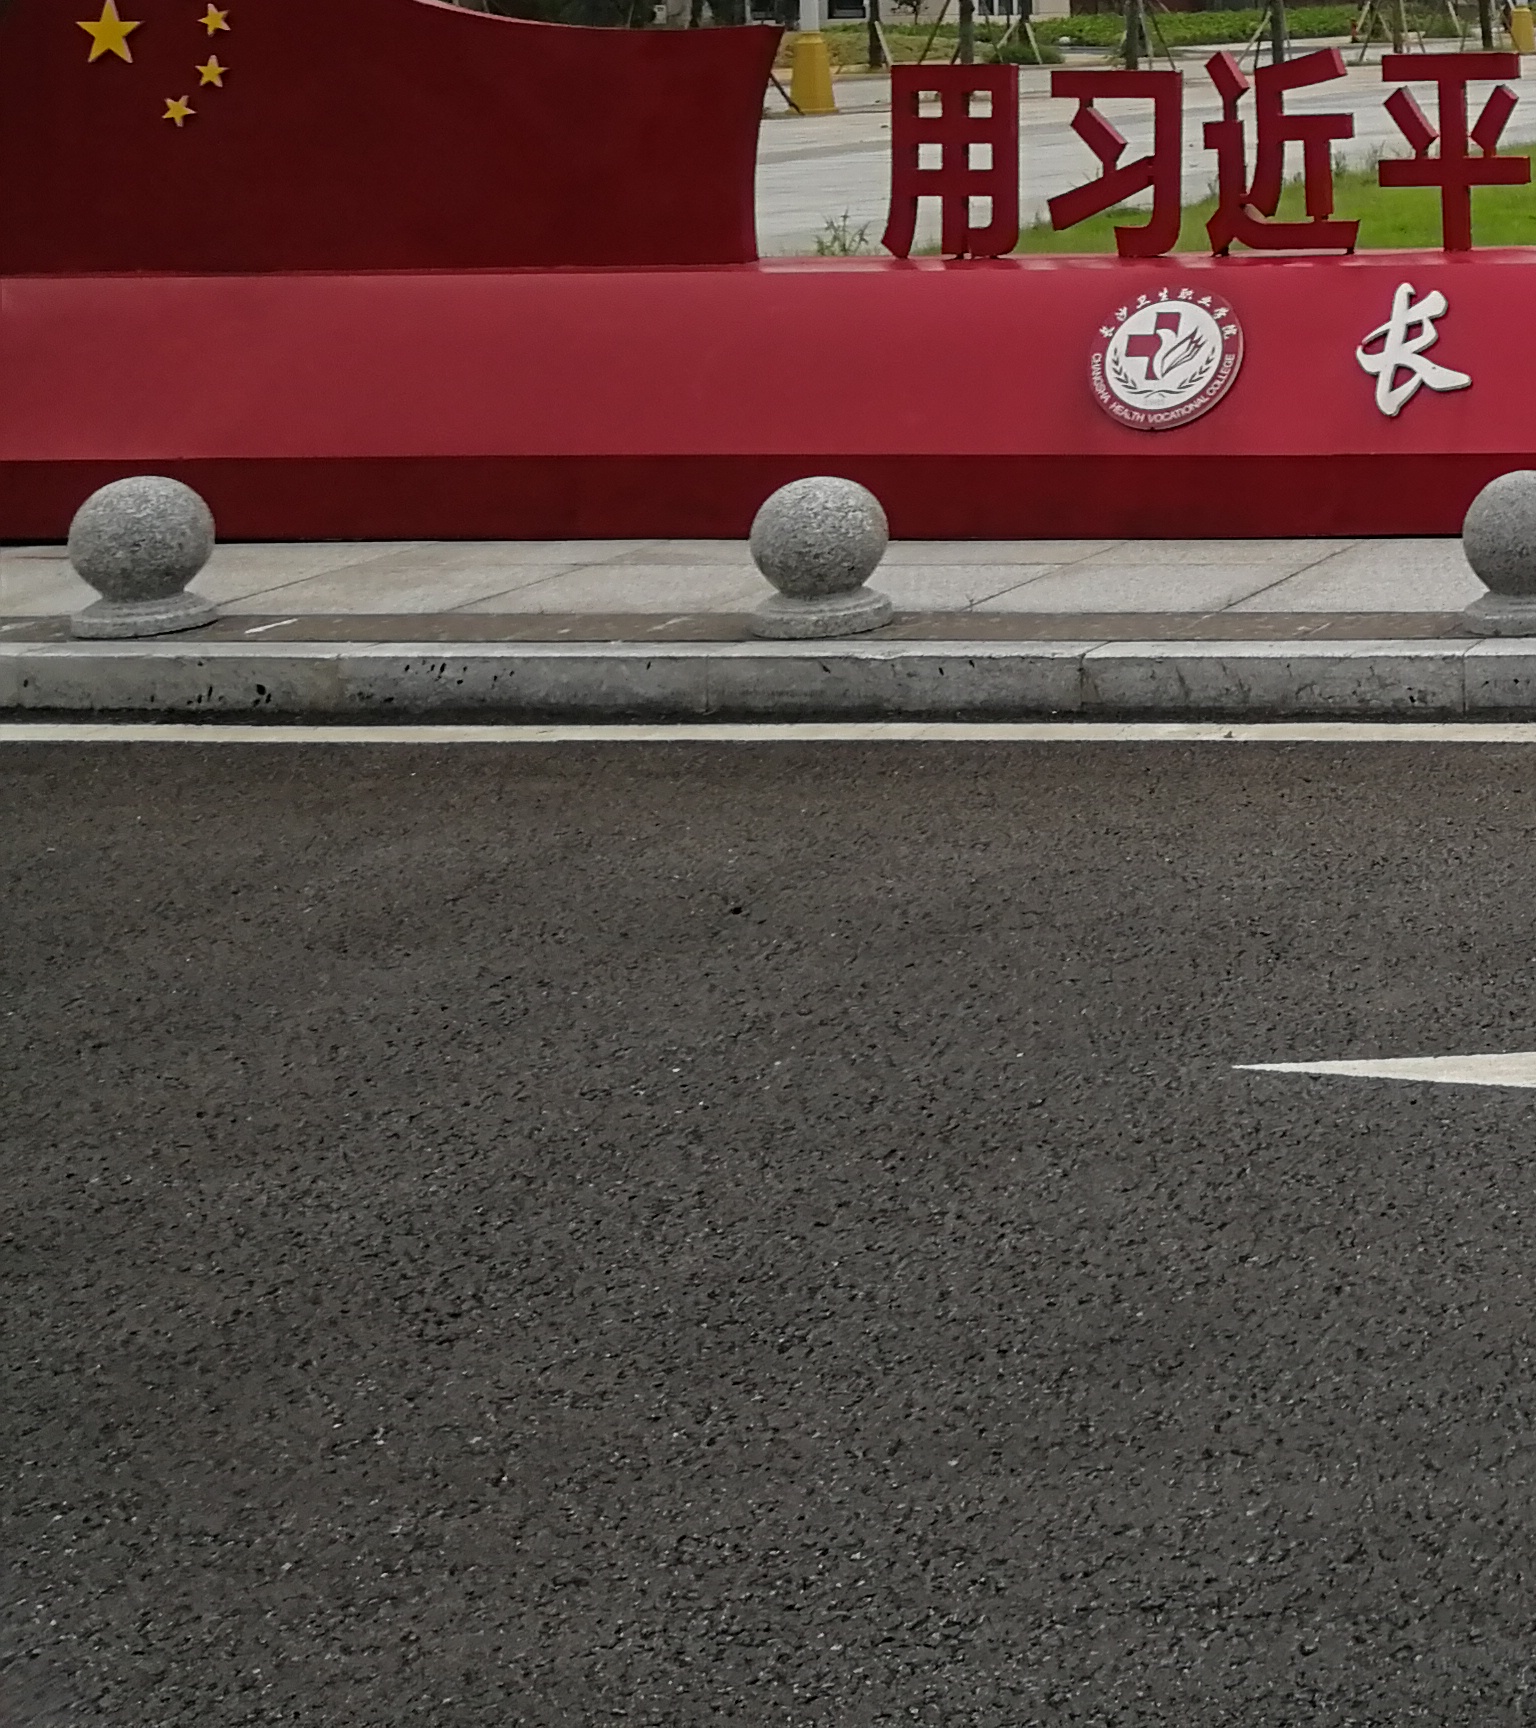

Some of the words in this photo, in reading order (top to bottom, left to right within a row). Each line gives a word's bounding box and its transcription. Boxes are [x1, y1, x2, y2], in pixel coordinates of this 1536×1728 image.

[1091, 353, 1111, 404] CHANGSHA
[1108, 401, 1146, 423] HEALTH
[1147, 396, 1210, 423] VOCATIONAL
[1205, 353, 1236, 397] COLLEGE
